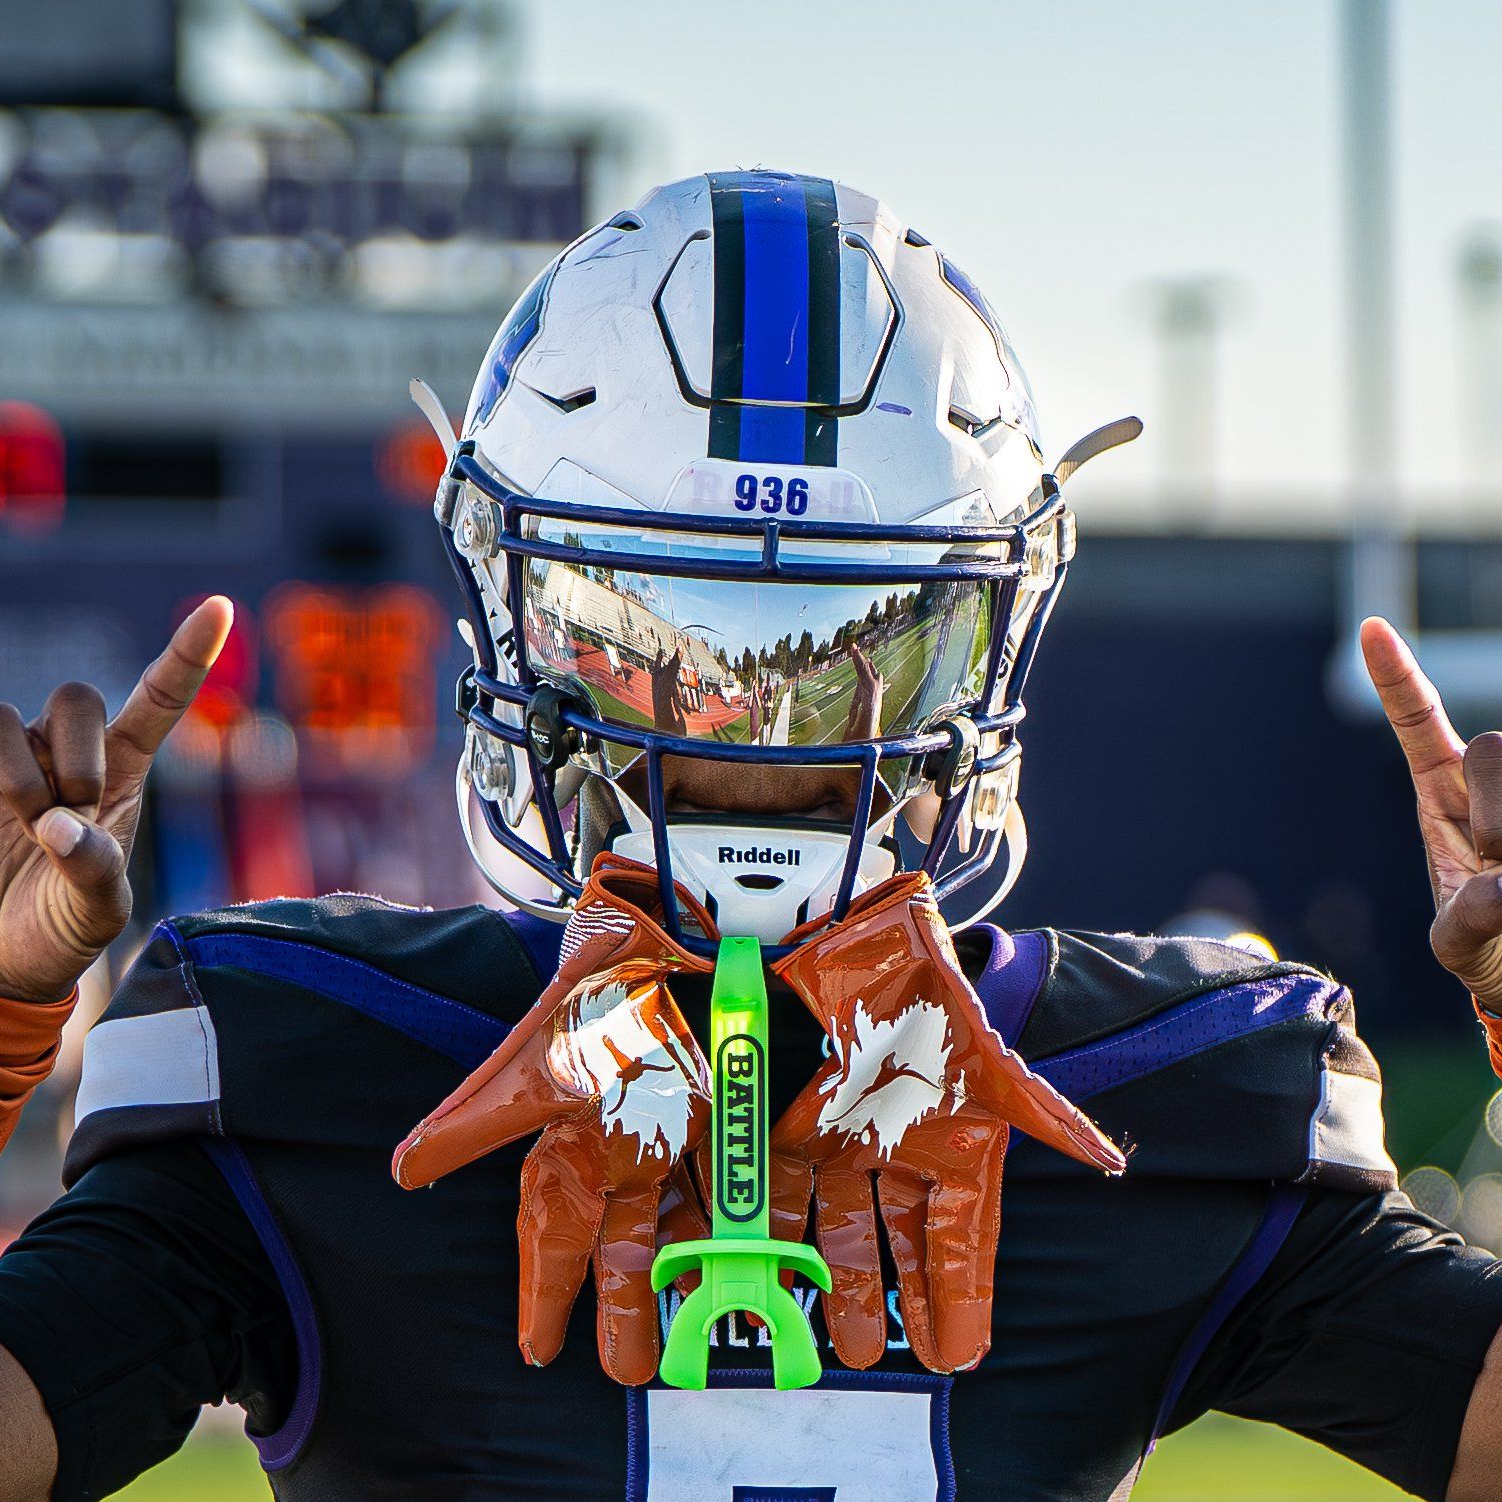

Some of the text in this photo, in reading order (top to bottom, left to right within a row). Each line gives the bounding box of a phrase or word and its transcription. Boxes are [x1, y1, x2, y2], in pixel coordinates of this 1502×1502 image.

[734, 474, 809, 516] 936
[718, 846, 801, 866] Riddell
[727, 1052, 754, 1204] BATTLE
